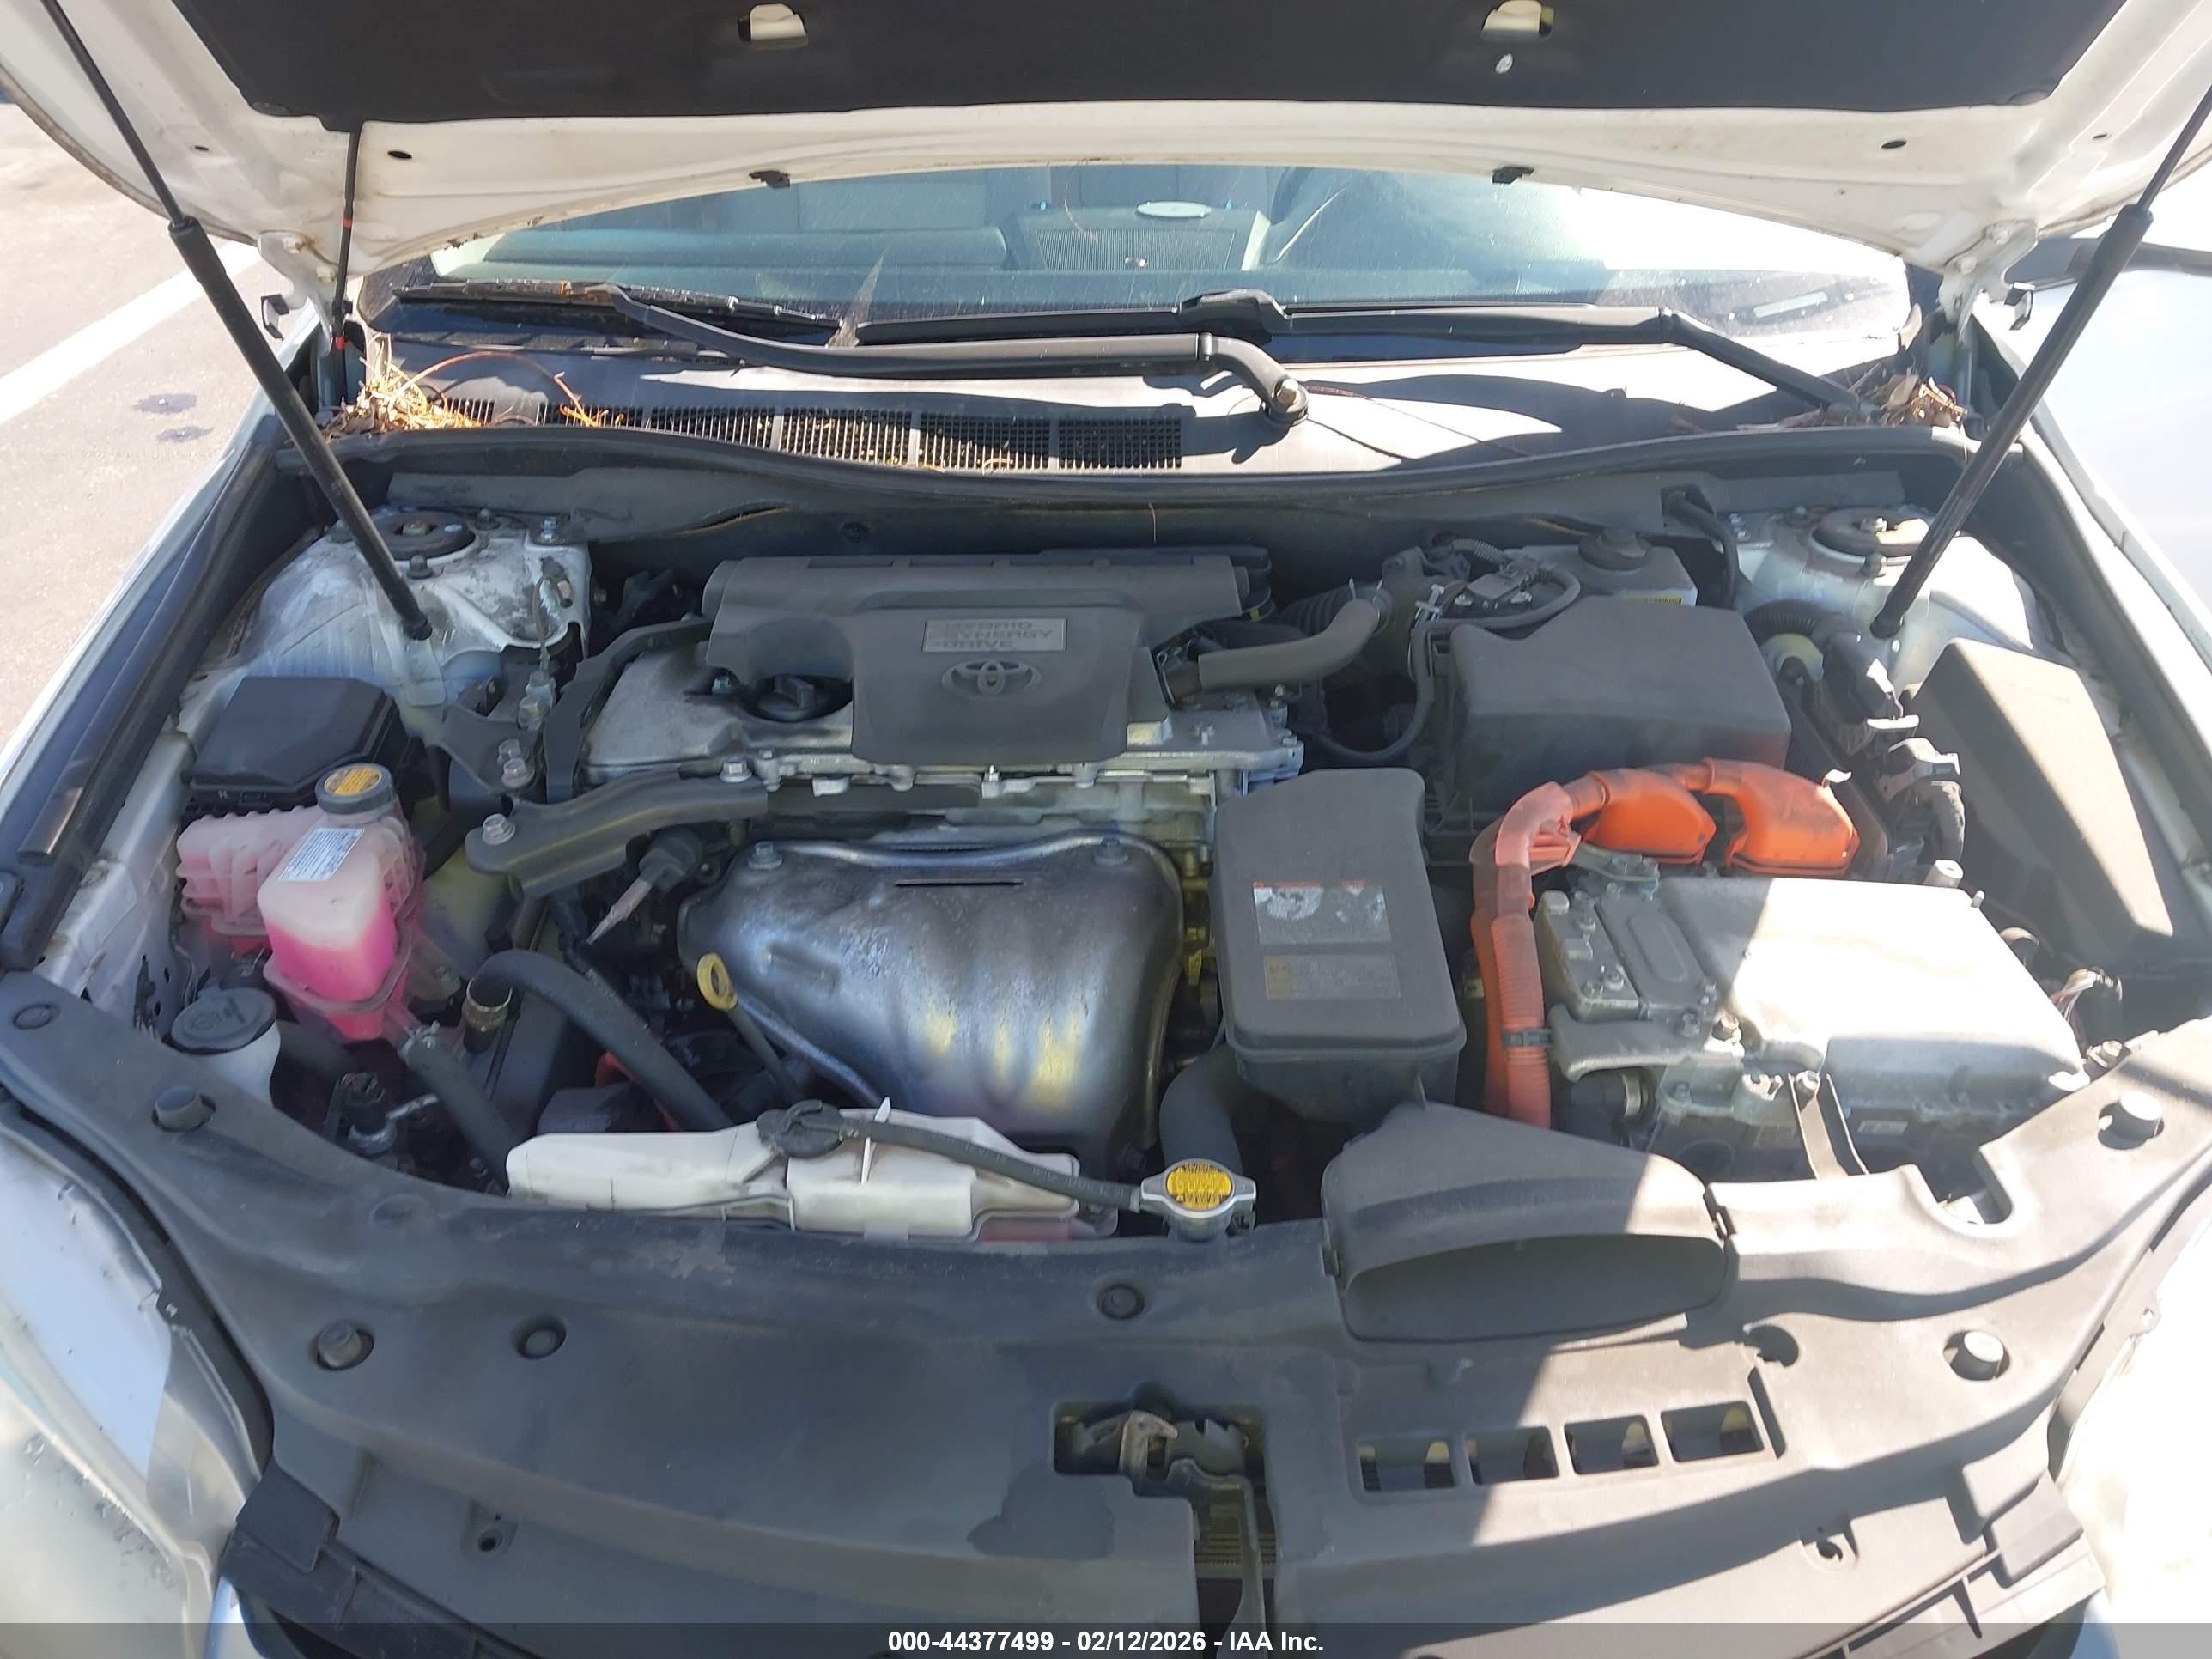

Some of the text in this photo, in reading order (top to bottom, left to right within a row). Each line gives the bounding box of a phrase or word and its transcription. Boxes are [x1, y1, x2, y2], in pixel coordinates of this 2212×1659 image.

[945, 621, 1033, 629] HYBRID
[944, 629, 1053, 639] SYNERGY
[943, 639, 1015, 649] DRIVE
